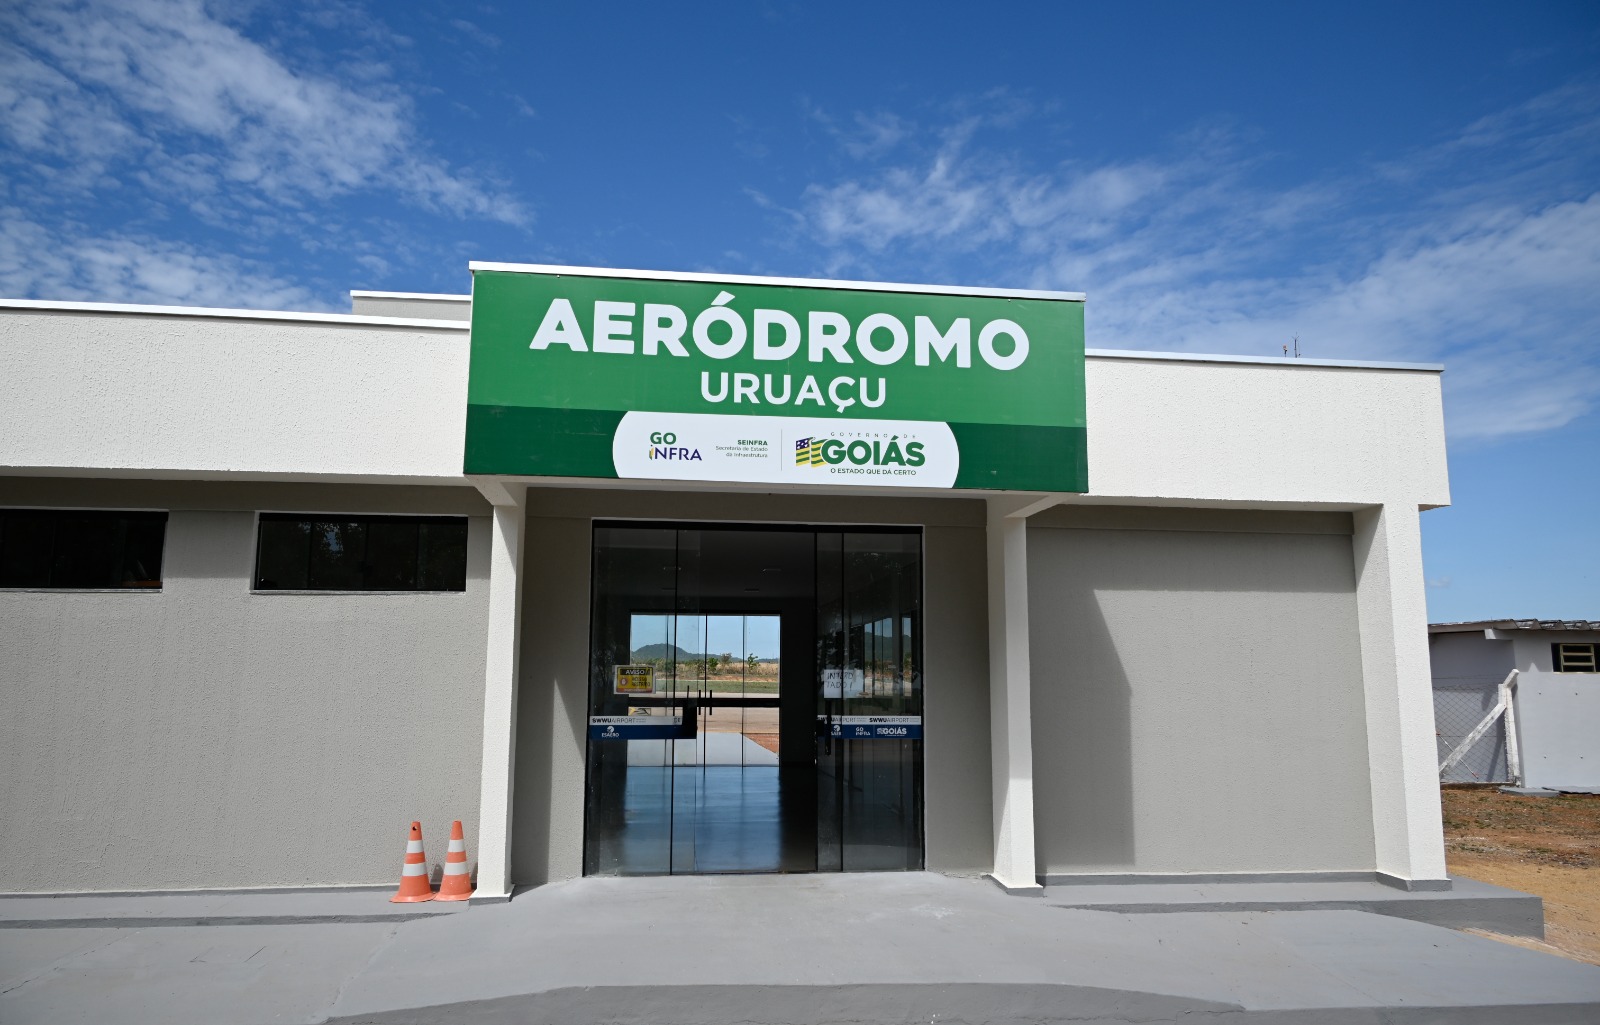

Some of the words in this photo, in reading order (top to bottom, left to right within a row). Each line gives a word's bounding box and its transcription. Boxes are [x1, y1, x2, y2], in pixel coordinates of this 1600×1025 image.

[529, 290, 1030, 371] AERÓDROMO
[701, 371, 887, 413] URUAÇU
[650, 431, 677, 445] GO
[821, 434, 926, 467] GOIÁS
[882, 726, 907, 735] GOIÁS
